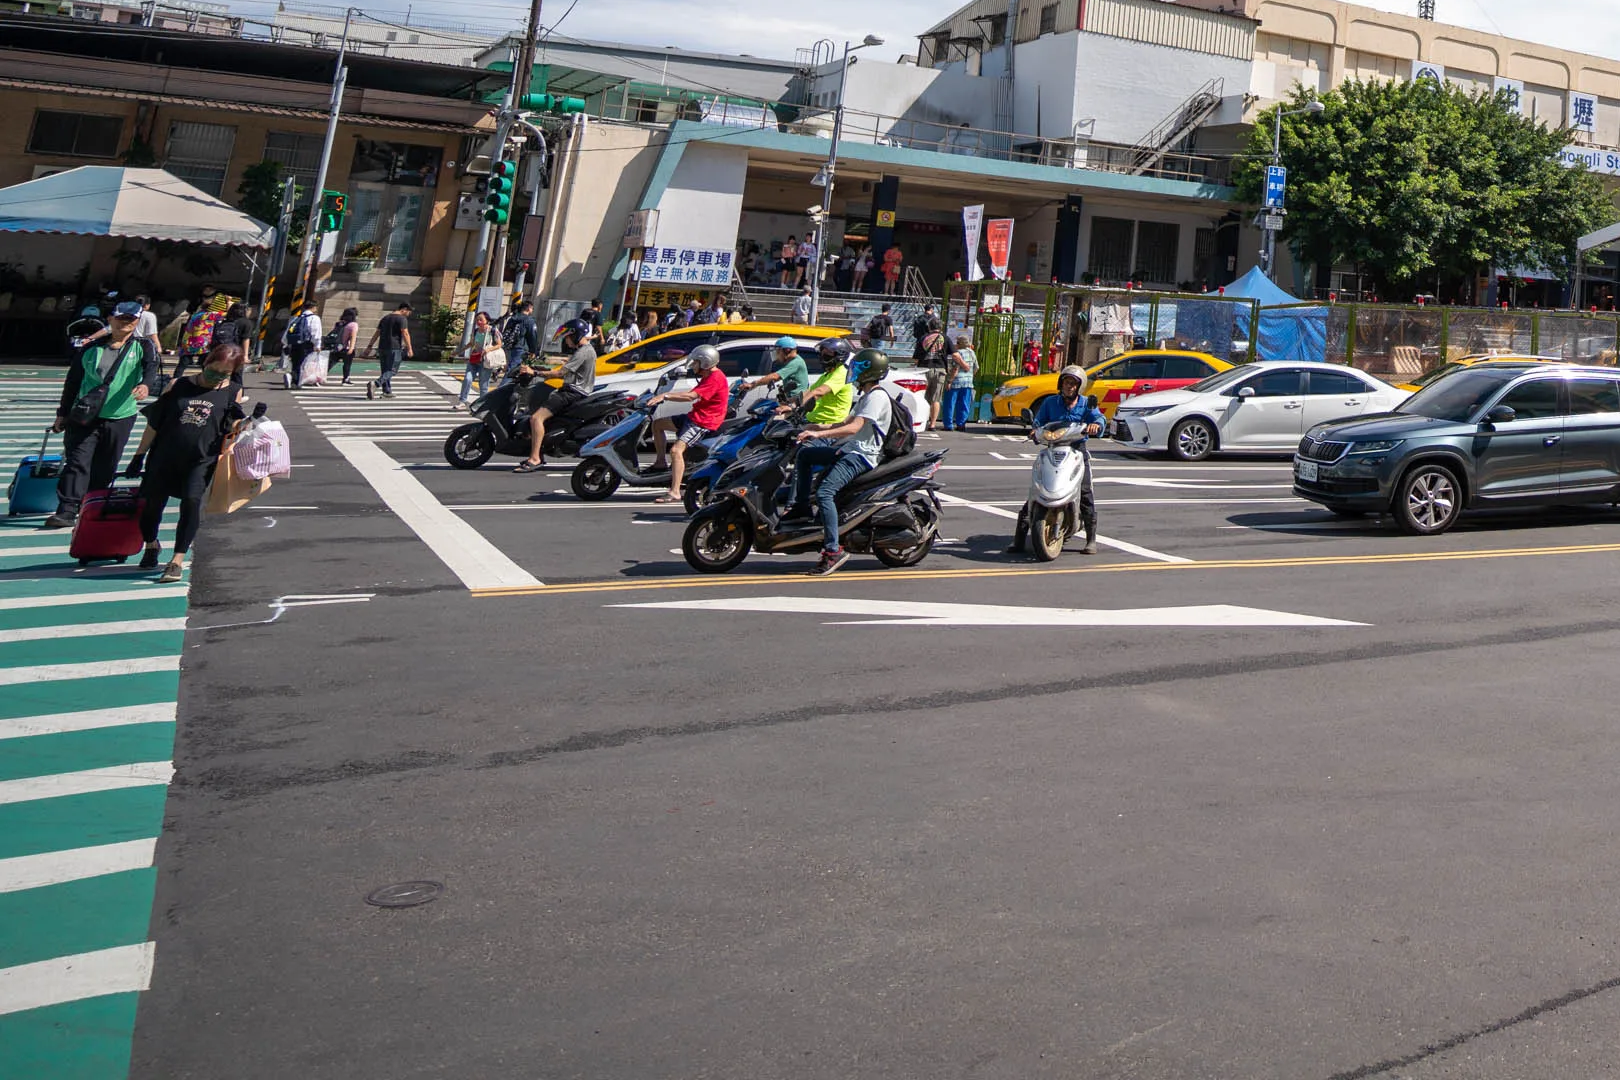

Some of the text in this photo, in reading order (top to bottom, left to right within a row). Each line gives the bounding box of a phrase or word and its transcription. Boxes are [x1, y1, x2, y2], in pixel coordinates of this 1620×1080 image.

[335, 196, 344, 211] 5
[644, 247, 732, 269] 喜馬停車場
[641, 264, 730, 283] 全年無休服務
